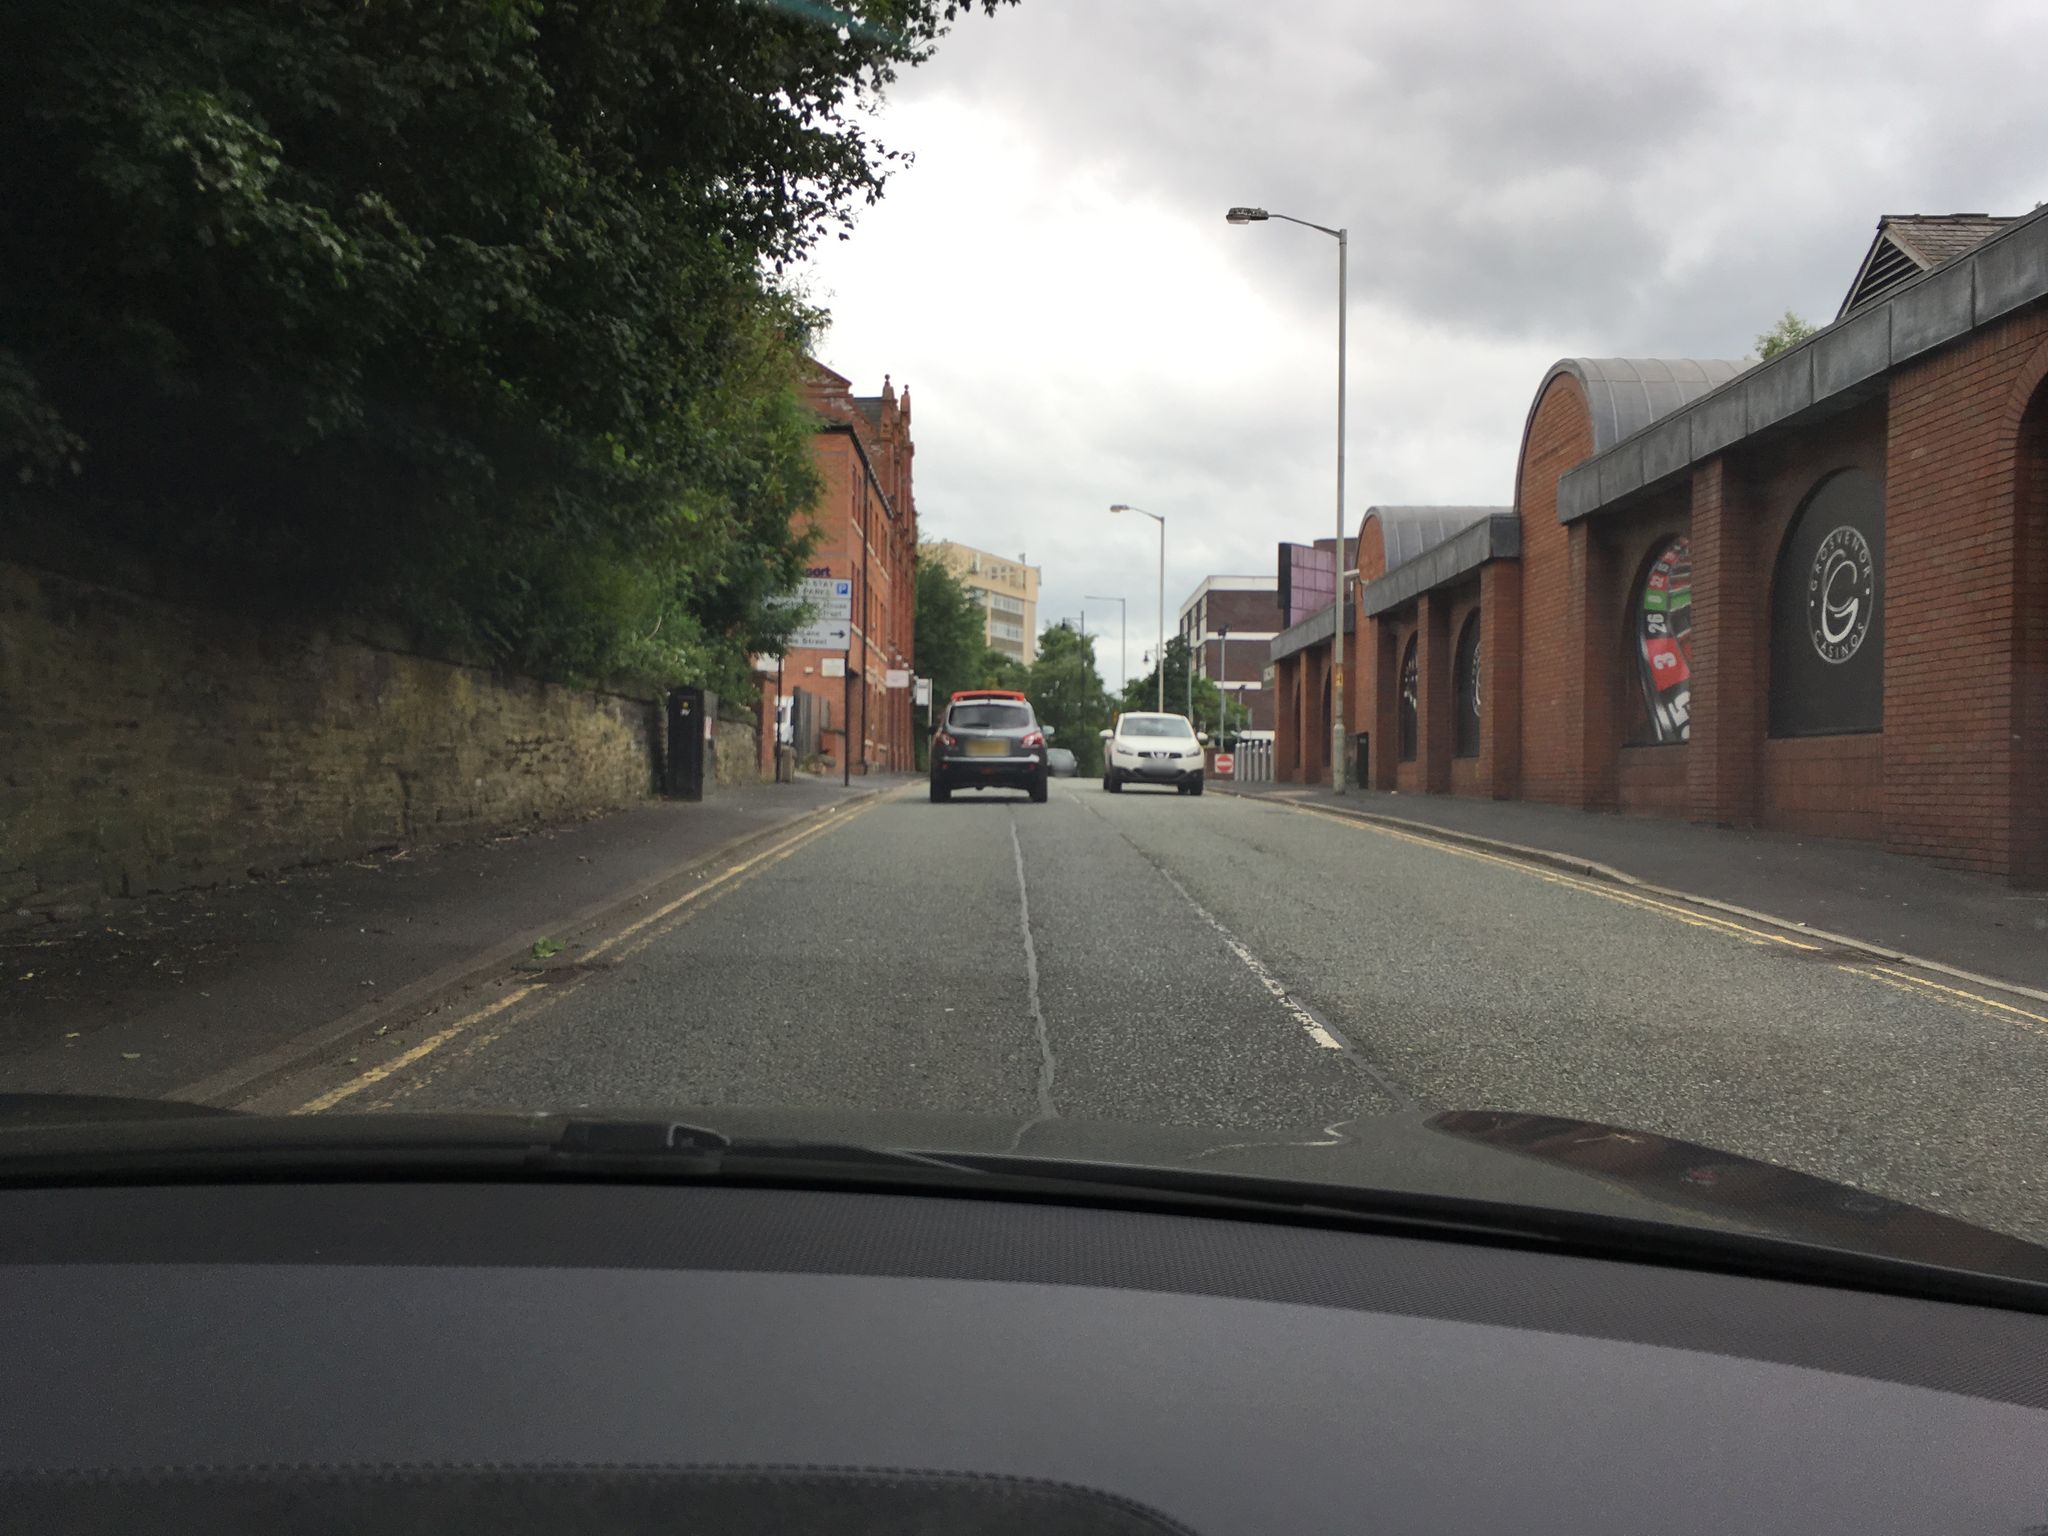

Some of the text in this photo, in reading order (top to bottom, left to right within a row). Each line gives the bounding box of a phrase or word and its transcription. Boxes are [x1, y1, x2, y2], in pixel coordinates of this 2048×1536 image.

[1809, 530, 1871, 591] GROSVENOR
[1647, 613, 1668, 633] 26
[1815, 621, 1865, 658] CASINOS
[1653, 652, 1677, 670] 3
